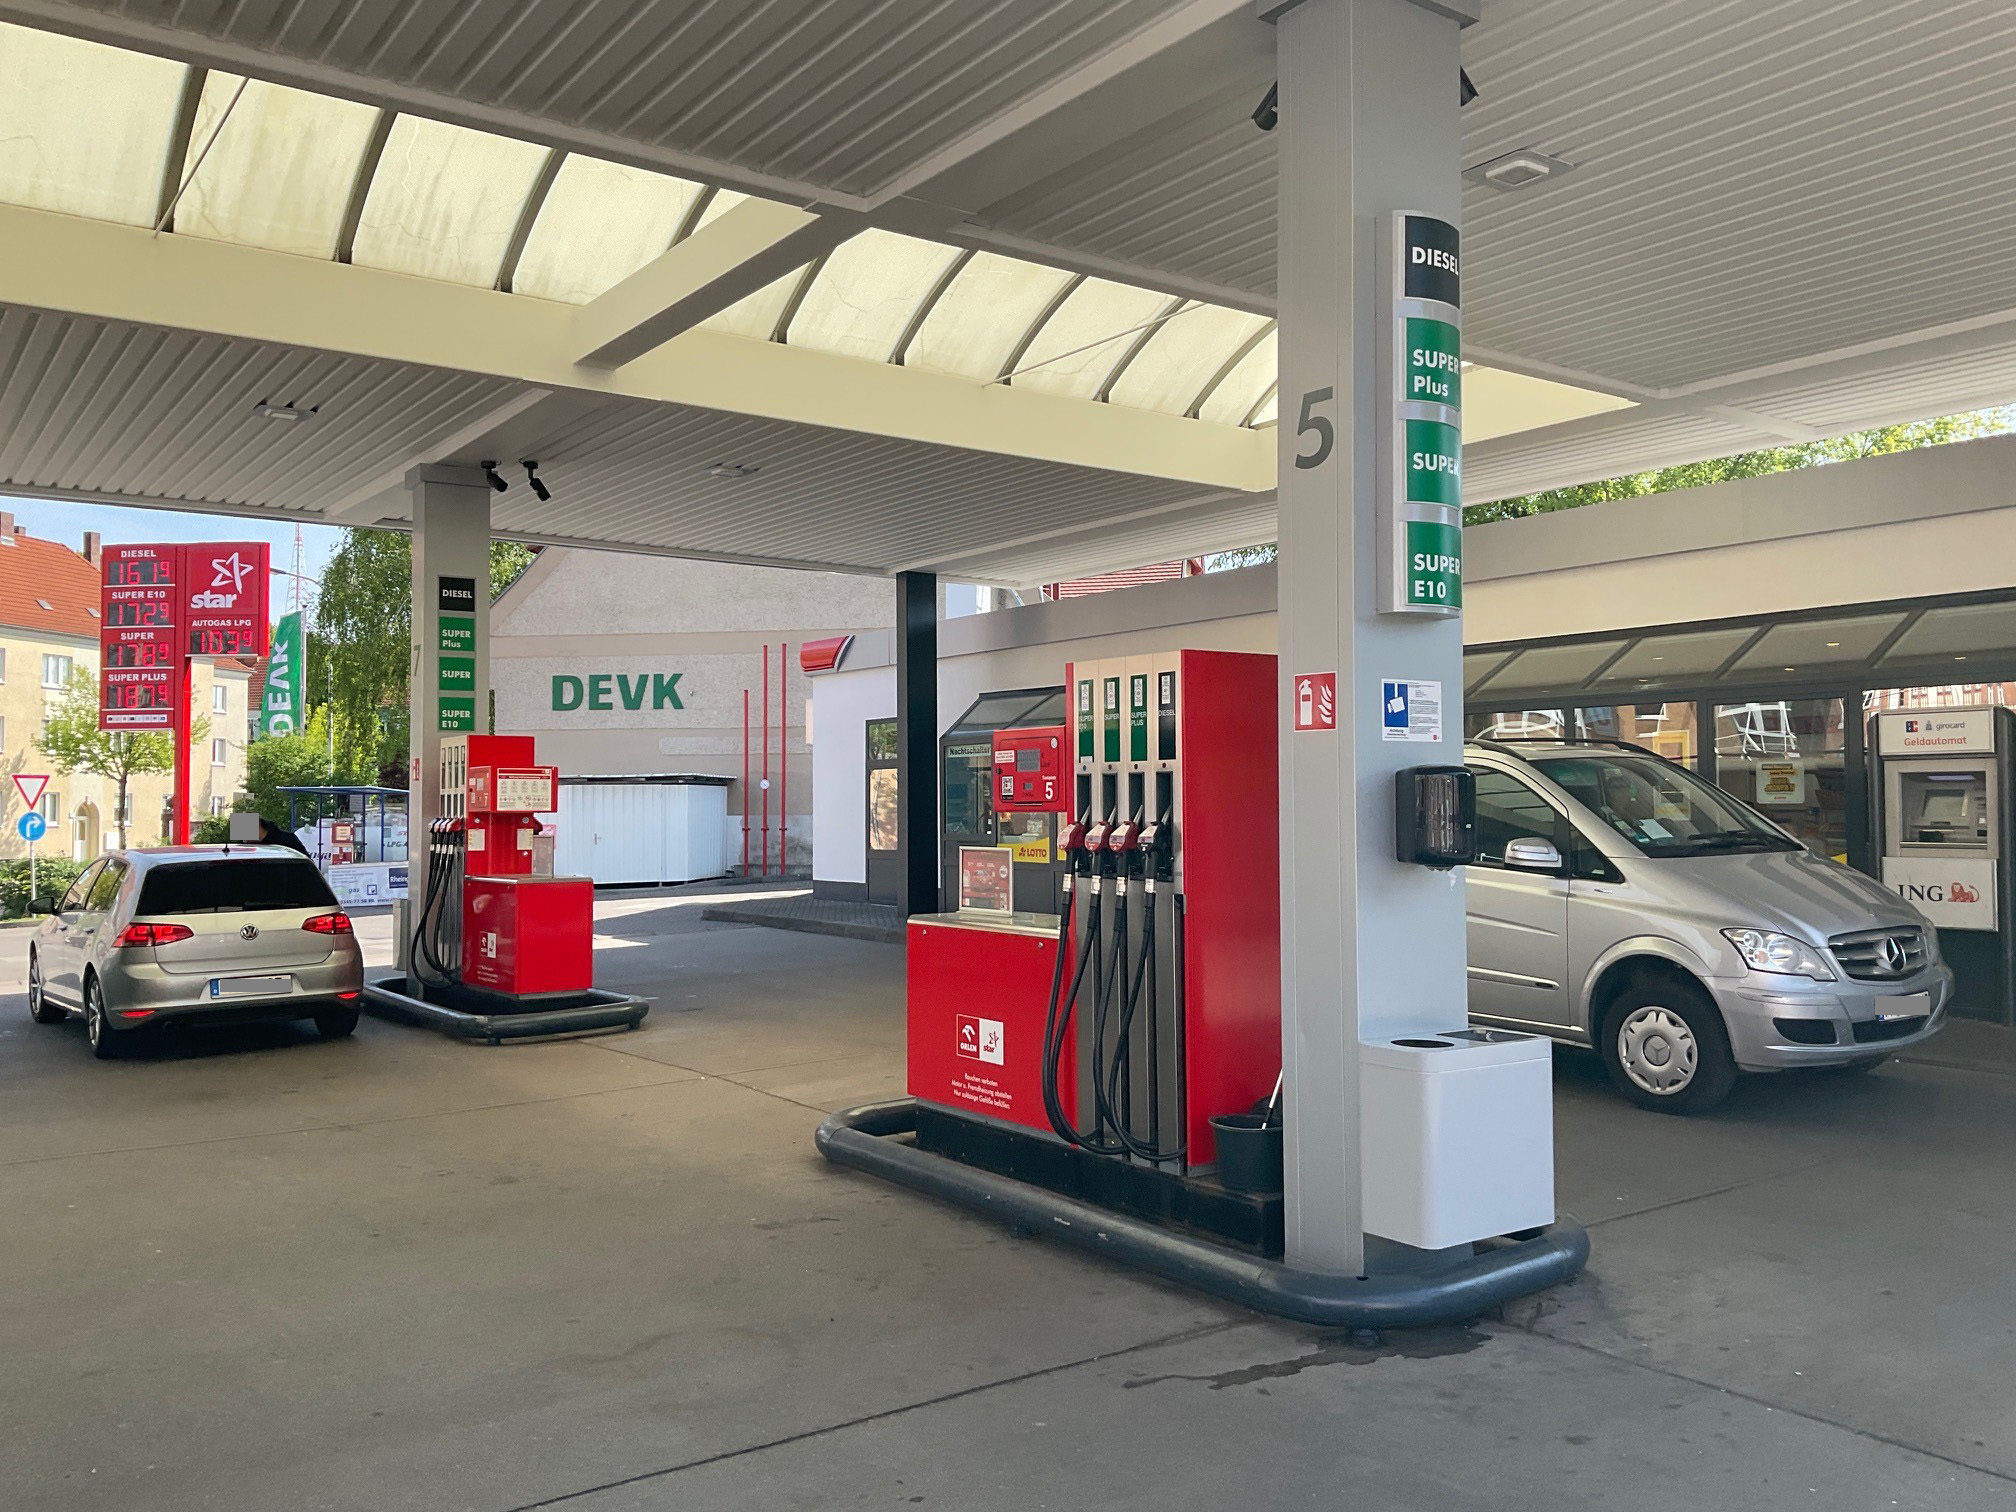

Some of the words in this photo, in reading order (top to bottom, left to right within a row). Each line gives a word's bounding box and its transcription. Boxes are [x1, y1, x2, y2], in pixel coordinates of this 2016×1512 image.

[1412, 246, 1459, 276] DIESEL
[1412, 348, 1459, 375] SUPER
[1413, 375, 1449, 397] Plus
[1295, 386, 1334, 469] 5
[1412, 452, 1460, 477] SUPER
[121, 549, 156, 558] DIESEL
[1413, 553, 1461, 576] SUPER
[111, 591, 144, 599] SUPER
[147, 590, 166, 599] E10
[442, 588, 473, 599] DIESEL
[1414, 580, 1447, 599] E10
[190, 589, 237, 609] star
[192, 619, 232, 627] AUTOGAS
[234, 619, 252, 627] LPG
[120, 632, 154, 640] SUPER
[442, 629, 471, 638] SUPER
[442, 639, 461, 648] Plus
[413, 644, 421, 677] 7
[108, 674, 139, 682] SUPER
[442, 670, 471, 679] SUPER
[269, 639, 294, 738] DEVK
[552, 673, 684, 711] DEVK
[442, 709, 471, 718] SUPER
[1158, 709, 1176, 717] DIESEL
[442, 720, 459, 728] E10
[1936, 721, 1965, 731] girocard
[1904, 736, 1967, 746] Geldautomat
[949, 744, 990, 755] Nachtschalter
[1045, 781, 1054, 800] 5
[1027, 848, 1047, 858] LOTTO
[1898, 884, 1943, 902] ING
[960, 1042, 977, 1052] ORLEN
[983, 1044, 995, 1053] star
[964, 1072, 980, 1082] Rauchen
